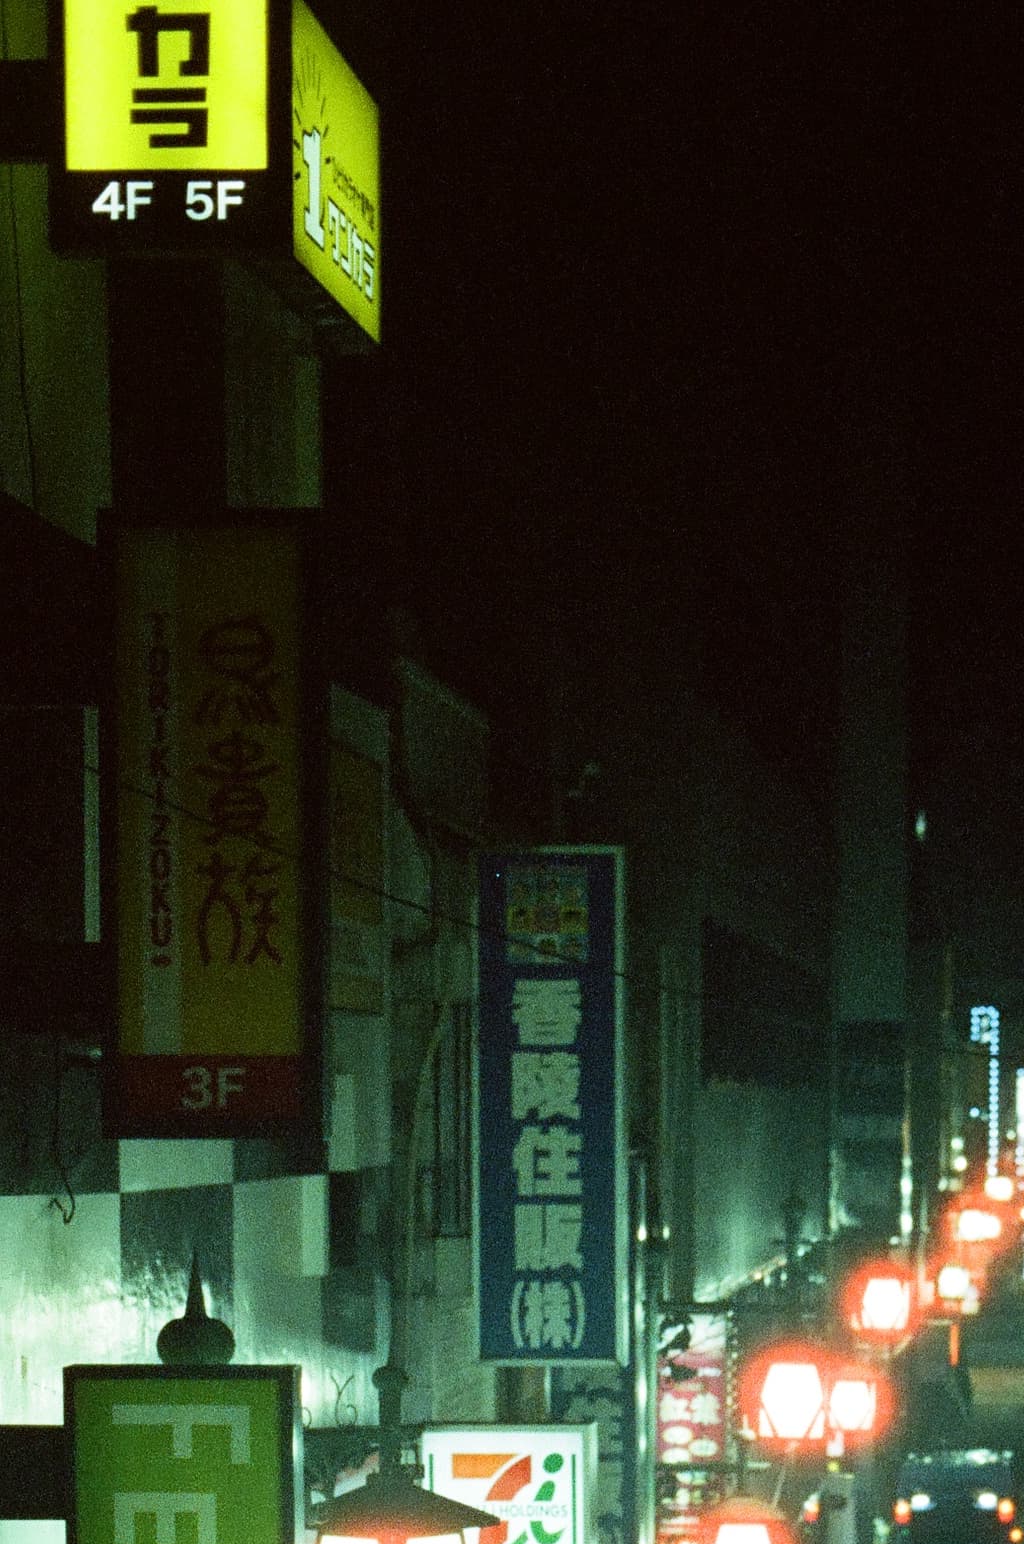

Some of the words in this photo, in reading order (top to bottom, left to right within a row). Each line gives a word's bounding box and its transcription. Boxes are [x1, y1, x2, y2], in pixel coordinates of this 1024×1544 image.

[91, 180, 154, 221] 4F
[184, 180, 246, 221] 5F
[180, 1065, 247, 1110] 3F
[499, 1503, 569, 1518] HOLDINGS
